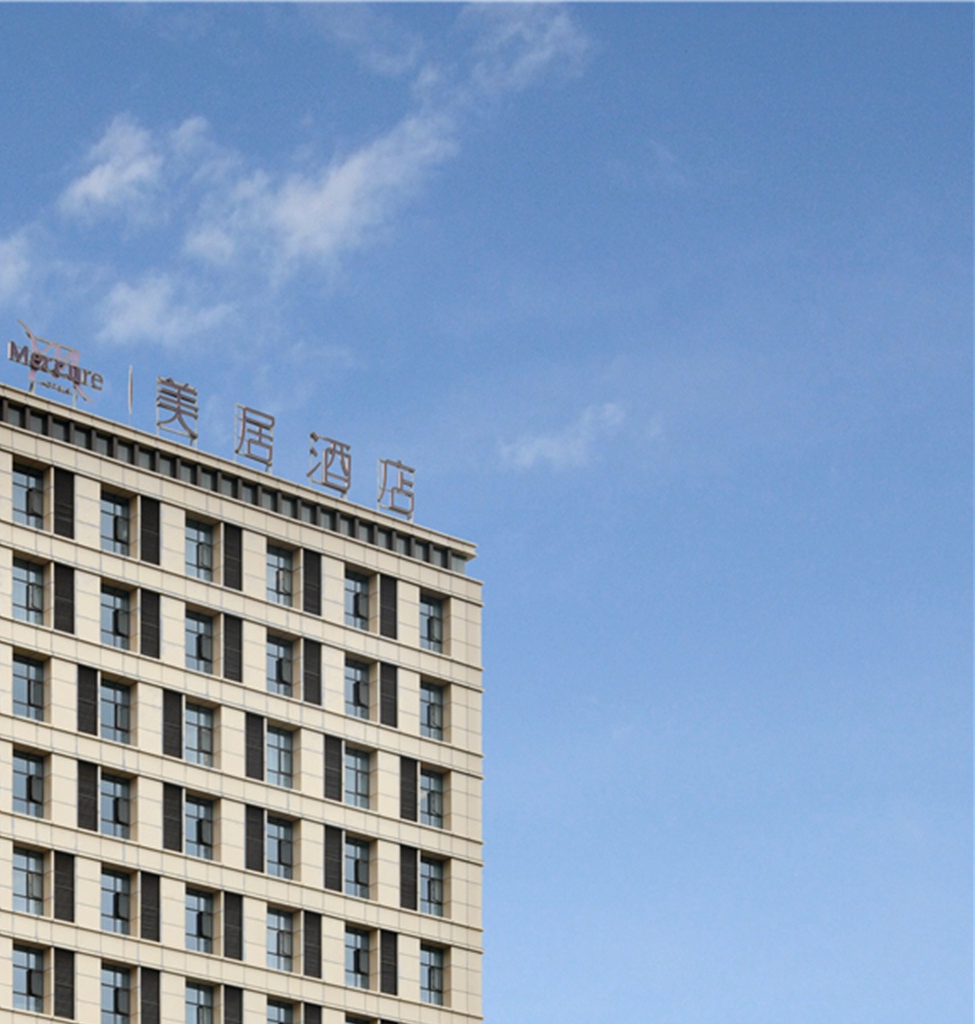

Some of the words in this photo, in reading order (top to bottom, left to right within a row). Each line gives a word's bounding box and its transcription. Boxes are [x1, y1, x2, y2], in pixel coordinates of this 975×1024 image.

[7, 340, 104, 391] Mercure
[156, 376, 417, 519] 美居酒店
